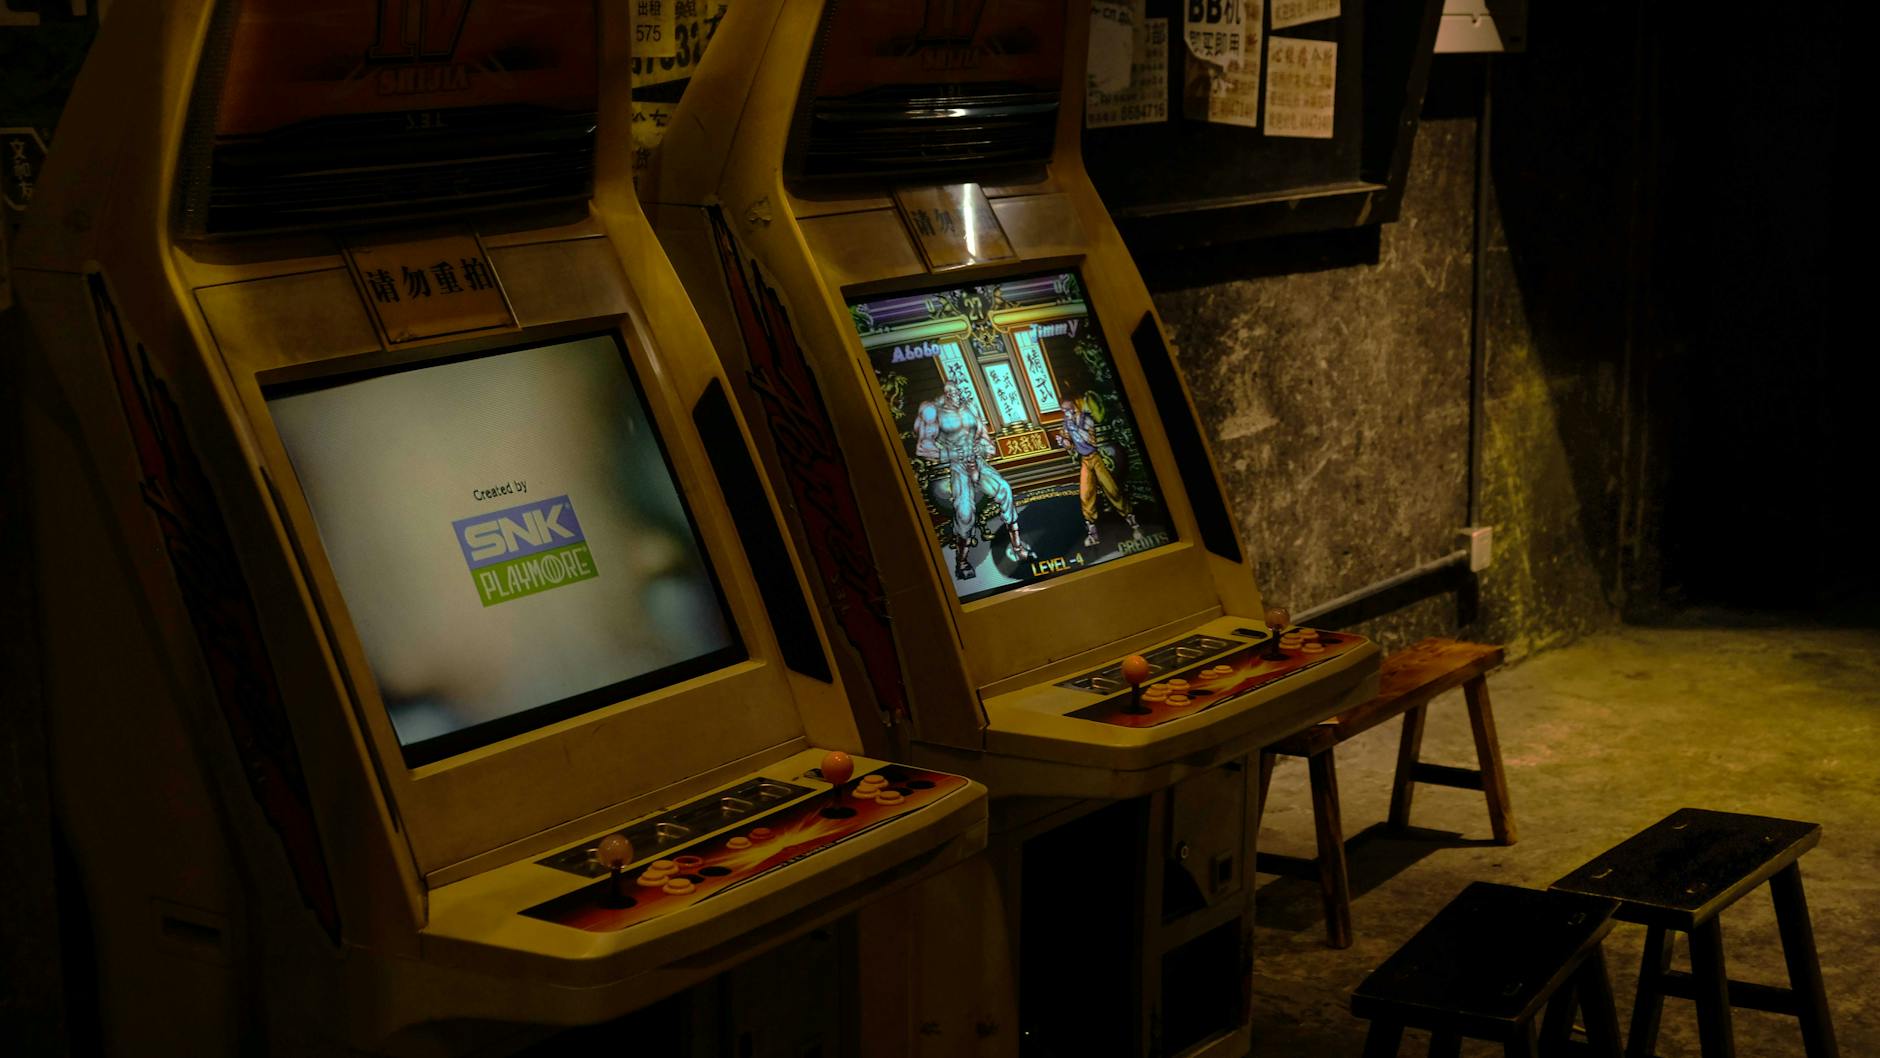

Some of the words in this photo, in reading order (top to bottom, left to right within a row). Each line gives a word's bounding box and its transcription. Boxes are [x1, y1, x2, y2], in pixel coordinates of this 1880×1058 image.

[635, 24, 662, 42] 575
[366, 257, 494, 303] 请勿重拍
[1030, 318, 1079, 343] Jimmy
[892, 342, 941, 364] Abobo
[473, 483, 514, 501] Created
[514, 480, 527, 493] by
[464, 503, 575, 561] SNK
[1117, 531, 1170, 555] CREDITS
[479, 548, 591, 601] PLAYMORE
